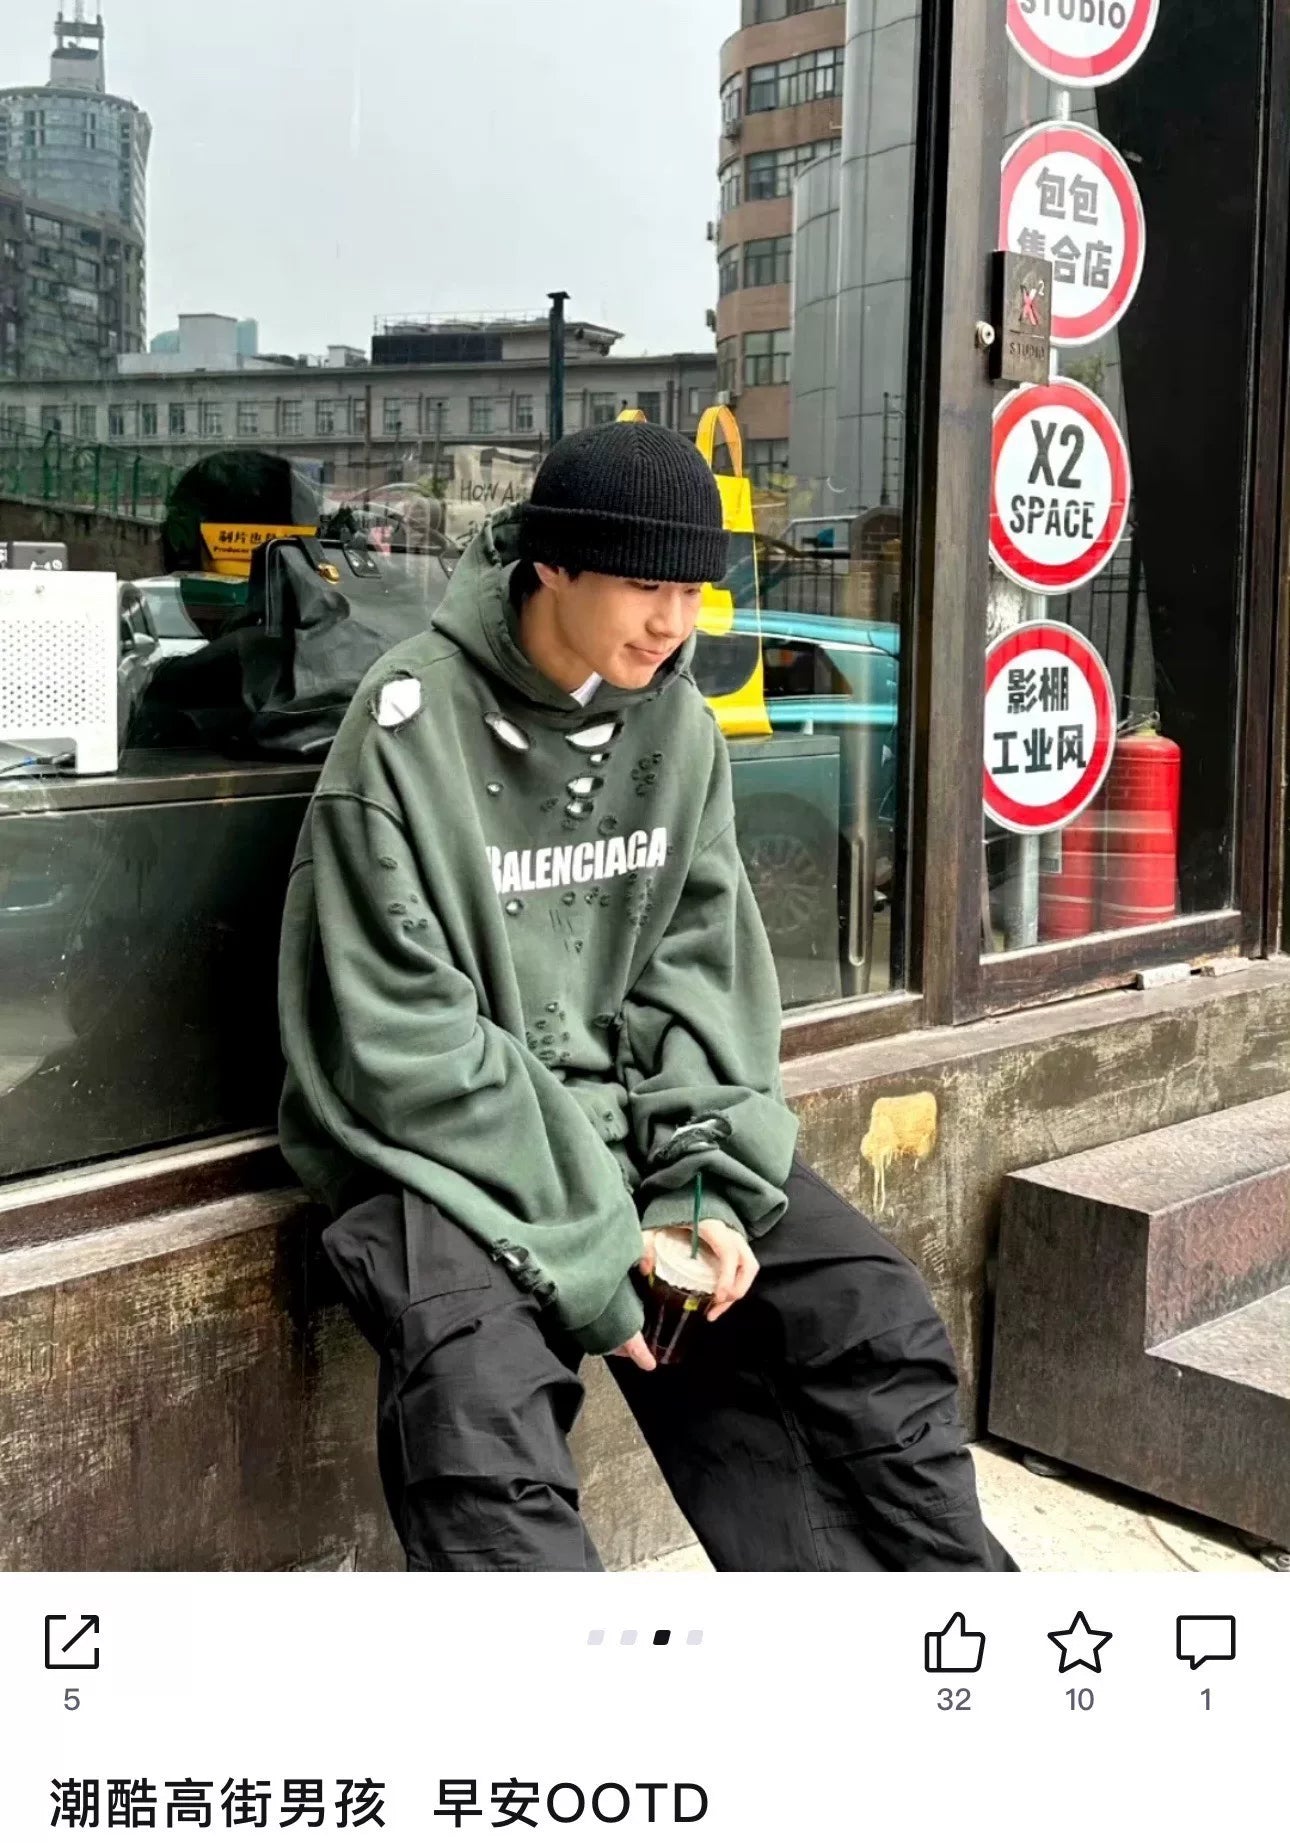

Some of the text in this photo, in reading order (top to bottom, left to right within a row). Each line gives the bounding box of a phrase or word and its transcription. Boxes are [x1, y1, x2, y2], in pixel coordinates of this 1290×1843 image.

[1035, 166, 1099, 226] 包包
[1027, 419, 1085, 489] X2
[1009, 494, 1095, 539] SPACE
[1007, 666, 1069, 714] 影棚
[991, 724, 1087, 774] 工业风
[485, 827, 668, 895] BALENCIAGA
